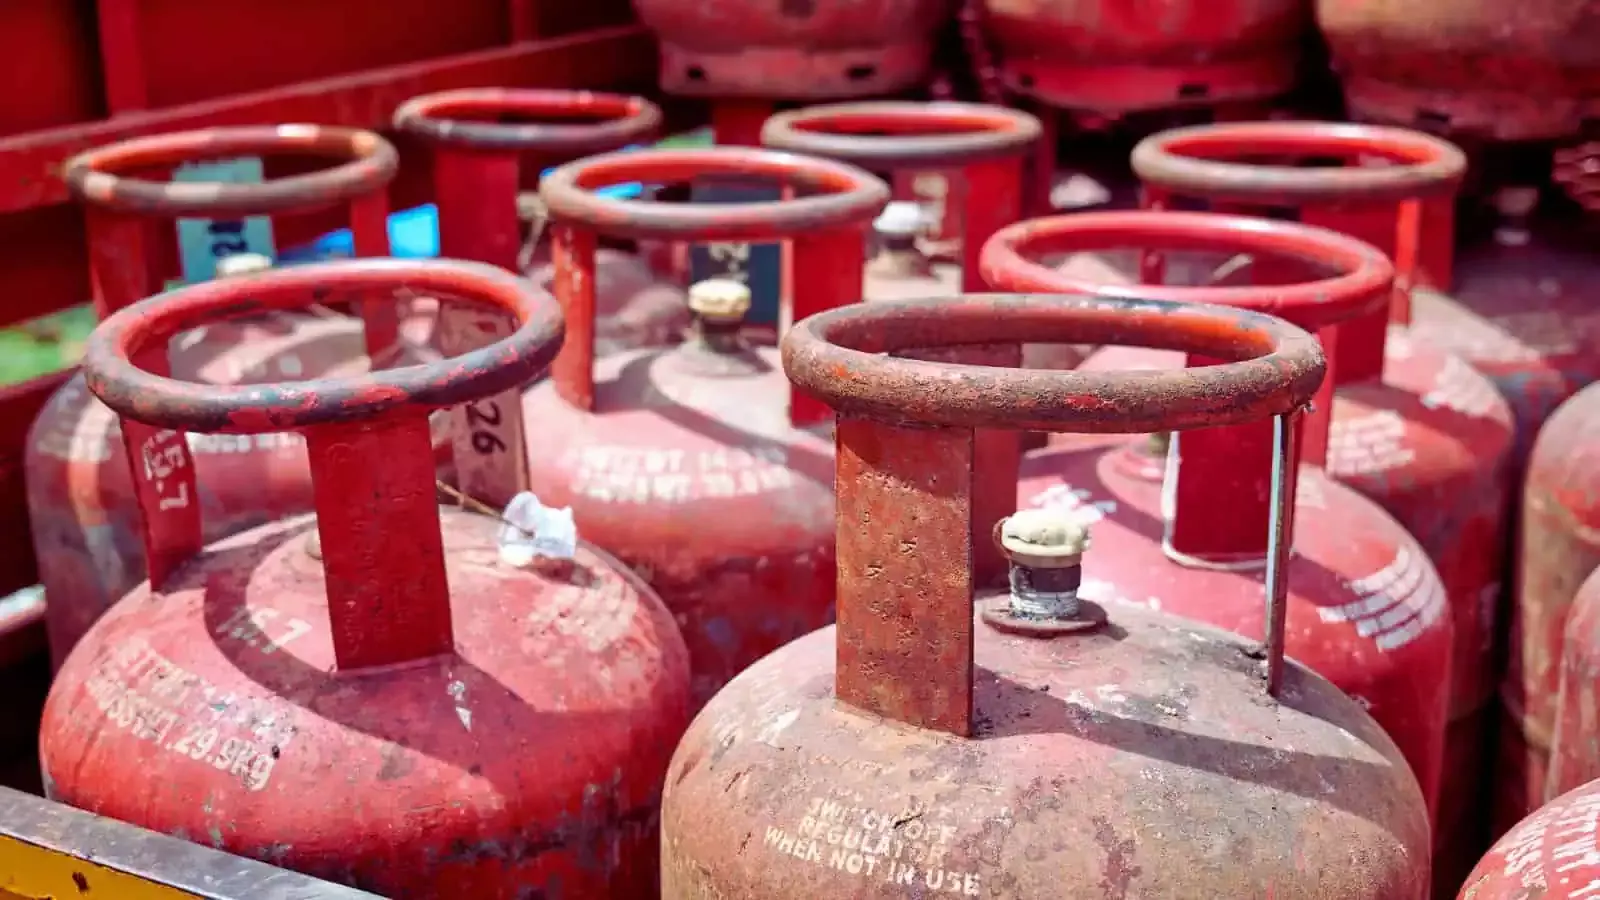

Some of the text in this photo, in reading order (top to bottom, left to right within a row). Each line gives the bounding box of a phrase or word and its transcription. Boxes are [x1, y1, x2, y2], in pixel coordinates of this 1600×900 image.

[466, 400, 507, 455] 26
[763, 825, 981, 898] WHEN NOT IN USE
